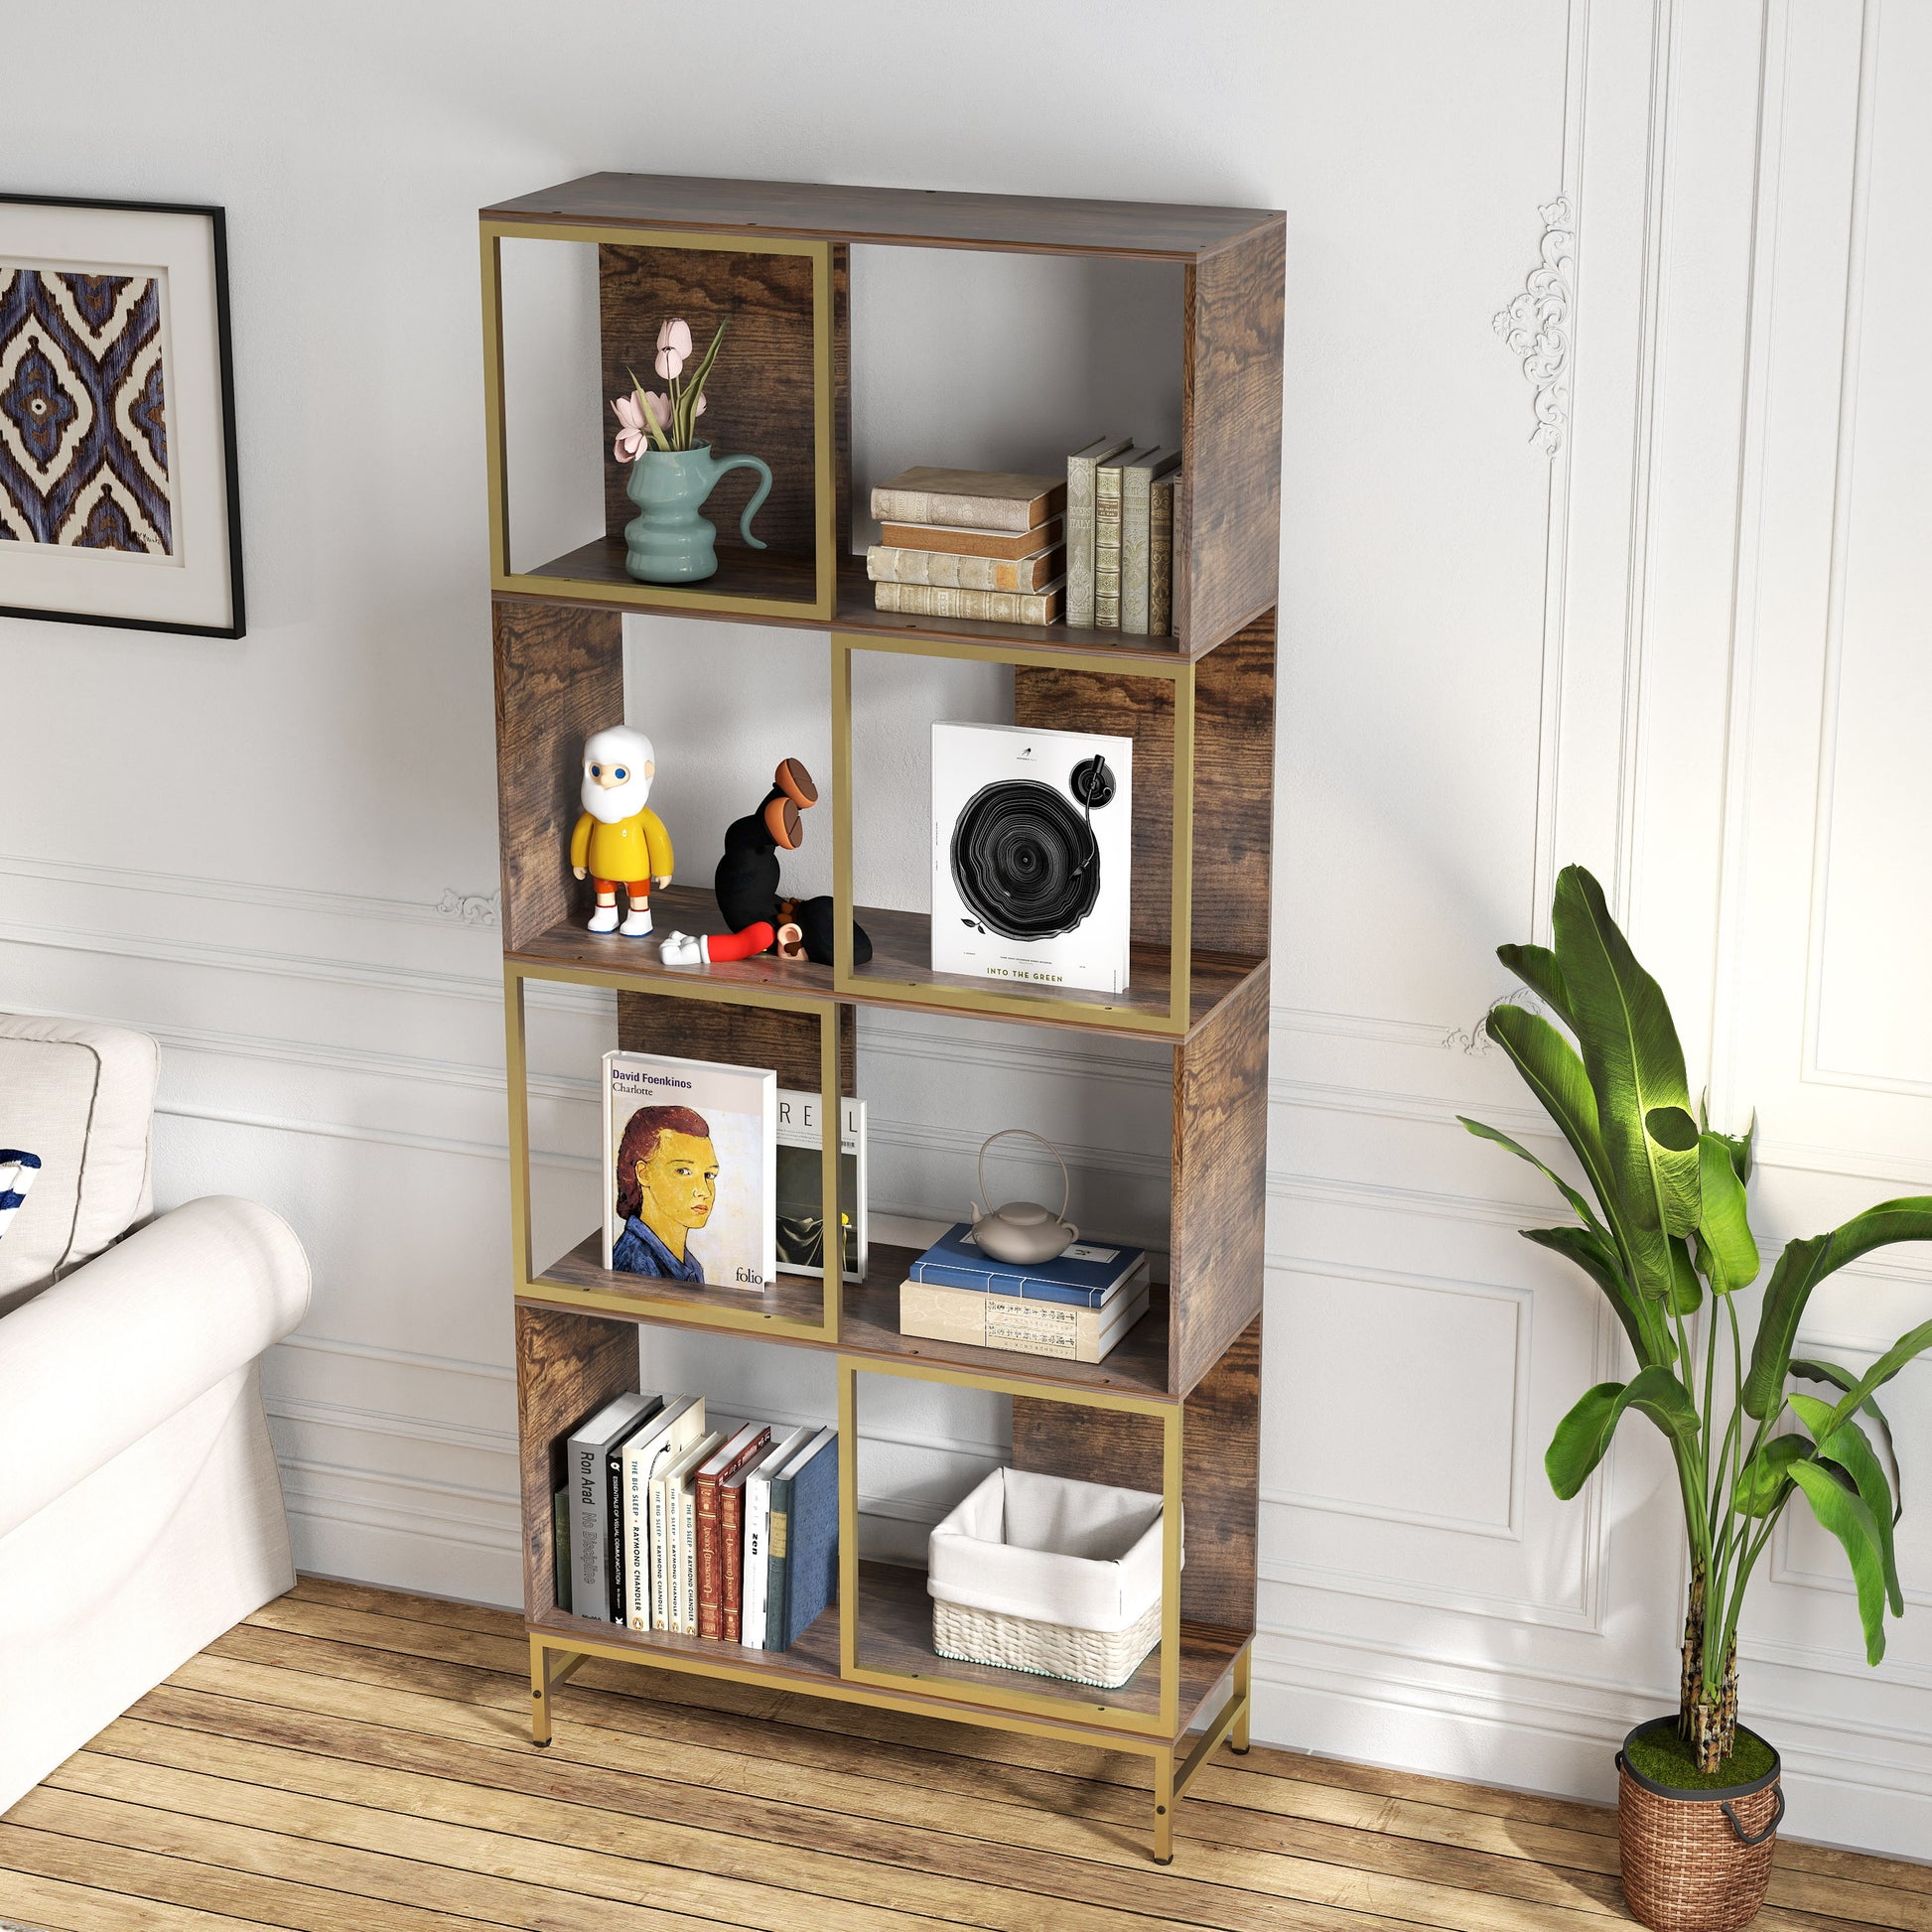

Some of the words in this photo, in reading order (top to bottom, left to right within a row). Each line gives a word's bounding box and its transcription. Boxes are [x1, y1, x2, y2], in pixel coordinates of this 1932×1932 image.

[987, 967, 1008, 976] INTO
[1034, 973, 1062, 982] GREEN
[613, 1069, 639, 1081] David
[642, 1073, 692, 1088] Foenkinos
[613, 1082, 653, 1095] Charlotte
[780, 1102, 858, 1133] REL
[736, 1267, 762, 1285] folio
[581, 1451, 594, 1474] Ron
[582, 1477, 595, 1505] Arad
[582, 1511, 597, 1529] No
[703, 1526, 714, 1554] JOURNEY
